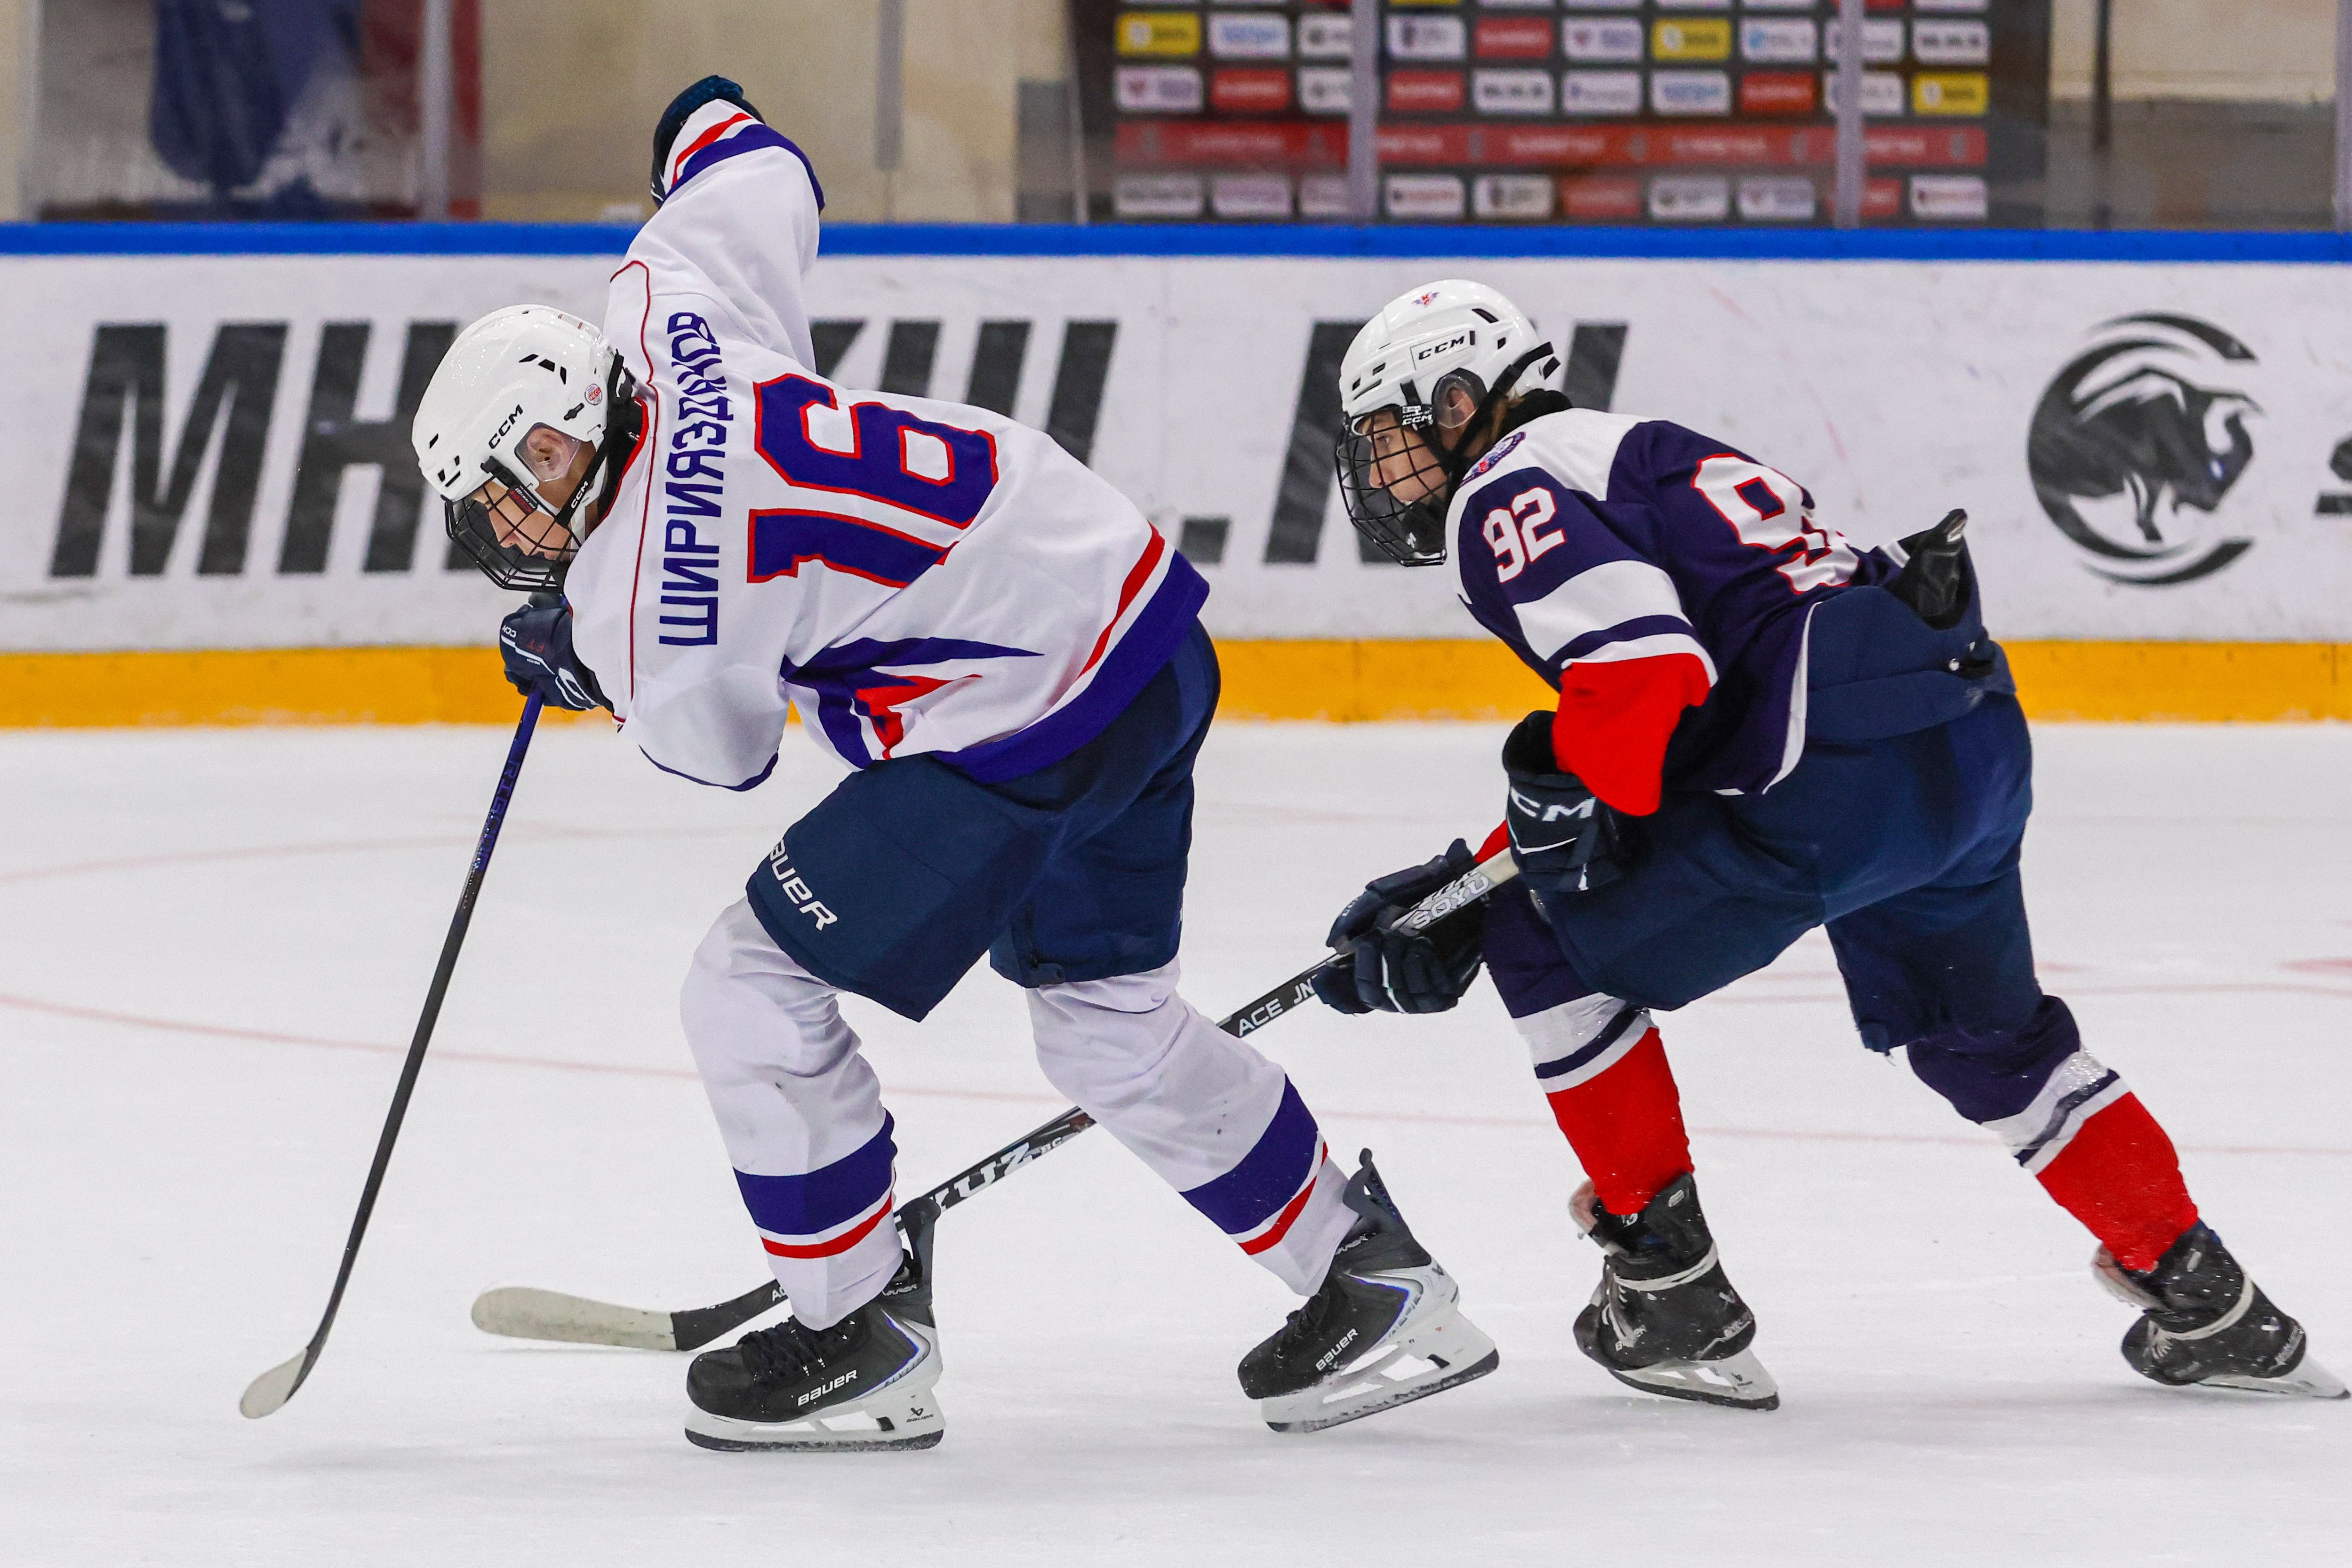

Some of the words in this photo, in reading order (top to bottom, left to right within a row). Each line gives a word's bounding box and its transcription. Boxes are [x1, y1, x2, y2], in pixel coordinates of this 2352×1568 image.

[1418, 336, 1465, 360] CCM
[488, 404, 523, 449] CCM
[570, 480, 588, 509] CCM
[659, 312, 734, 646] ШИРИЯЗДАНОВ
[747, 373, 999, 589] 16
[1482, 487, 1567, 584] 92
[1239, 998, 1283, 1037] ACE
[1294, 973, 1317, 1004] JN
[1315, 1328, 1359, 1371] BAUER
[797, 1369, 858, 1407] BAUER
[906, 1413, 934, 1423] BAUER
